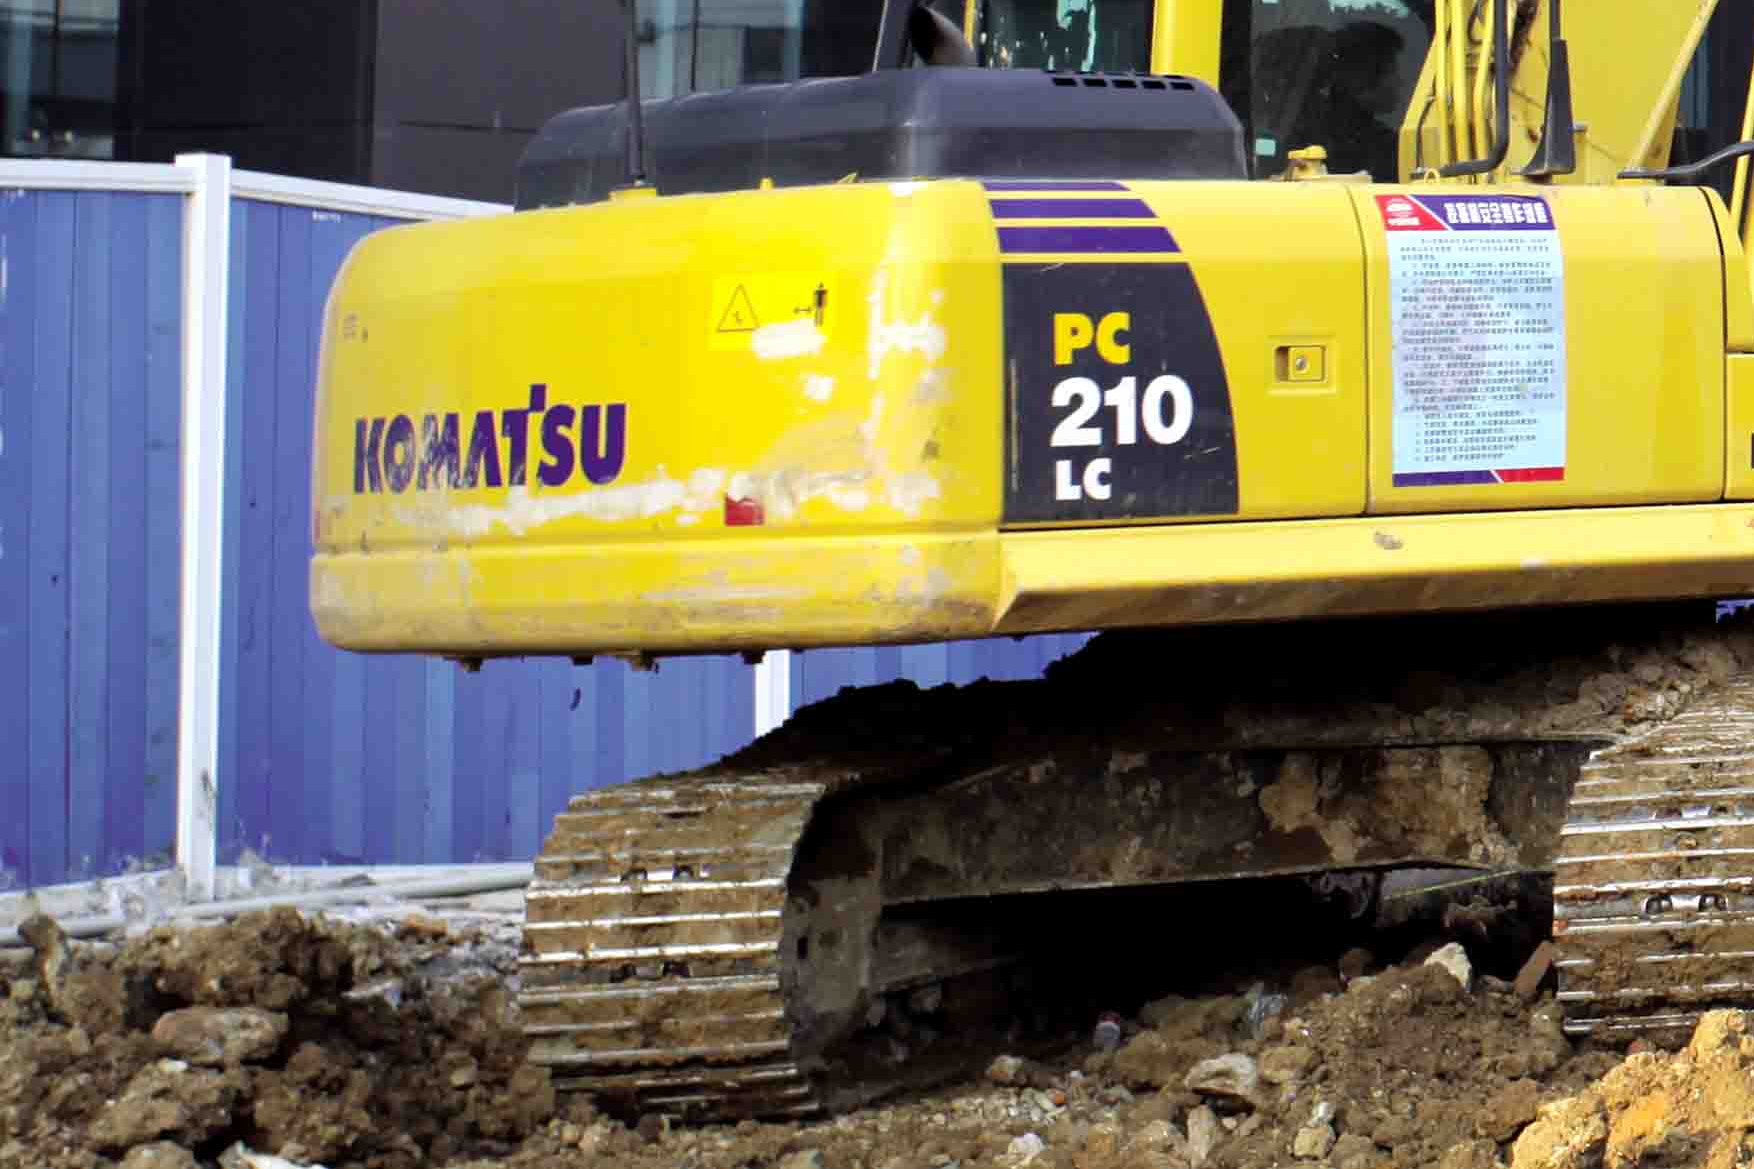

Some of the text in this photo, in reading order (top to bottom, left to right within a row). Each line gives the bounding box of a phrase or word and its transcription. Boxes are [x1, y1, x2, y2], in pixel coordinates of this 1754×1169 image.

[1053, 311, 1132, 366] PC
[353, 382, 627, 495] KOMATSU
[1050, 374, 1194, 448] 210
[1055, 457, 1113, 502] LC
